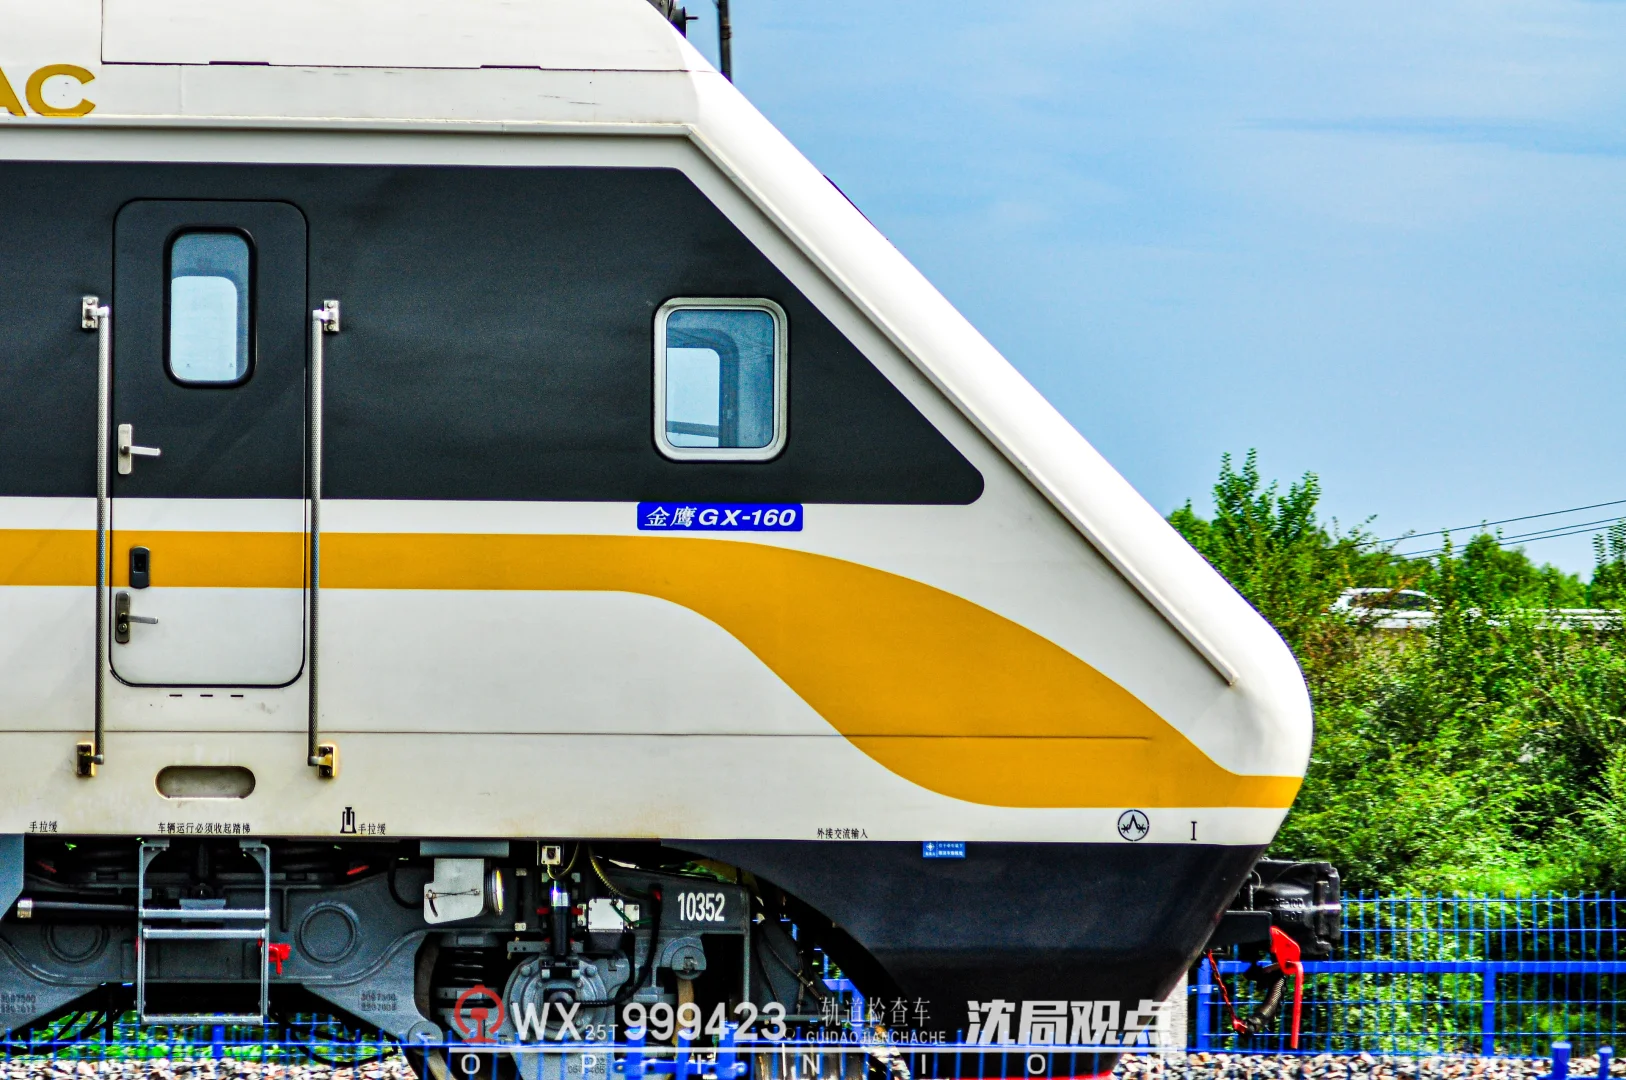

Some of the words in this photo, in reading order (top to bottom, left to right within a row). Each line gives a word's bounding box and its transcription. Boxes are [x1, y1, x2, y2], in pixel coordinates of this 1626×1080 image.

[644, 506, 697, 528] 金鹰
[698, 508, 796, 527] GX-160
[157, 822, 251, 834] 车辆运行必须收起踏梯
[816, 827, 868, 840] 外接交流输入
[677, 892, 726, 922] 10352
